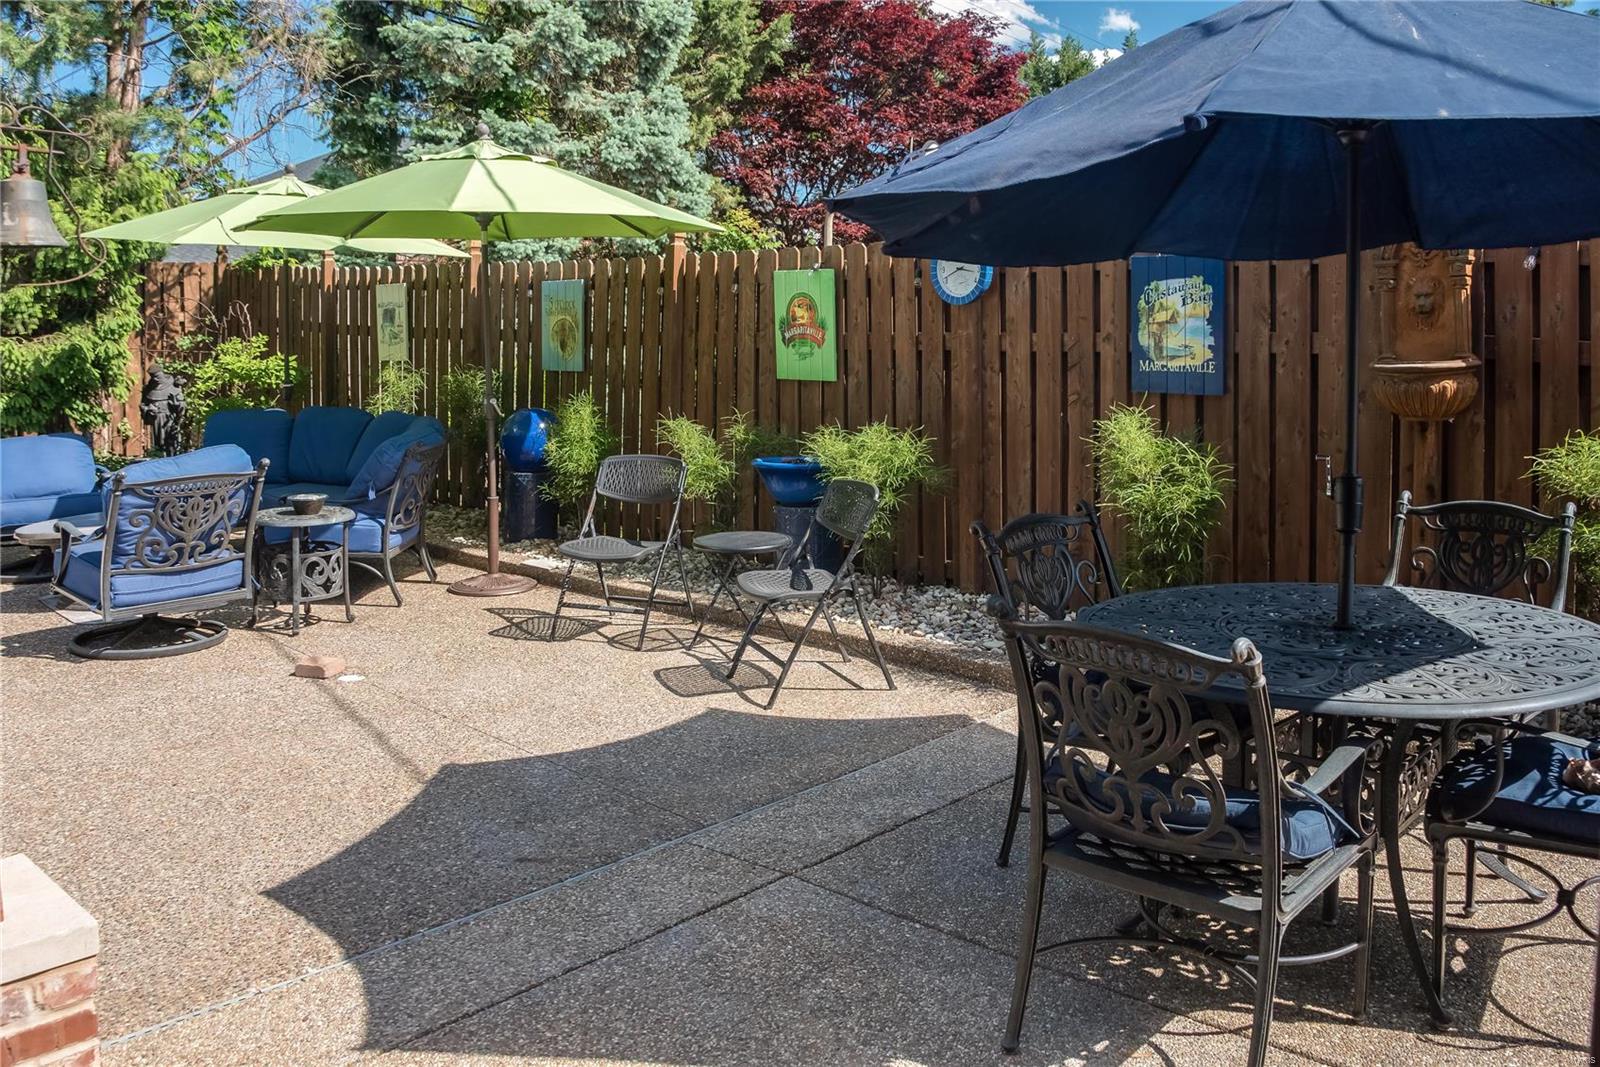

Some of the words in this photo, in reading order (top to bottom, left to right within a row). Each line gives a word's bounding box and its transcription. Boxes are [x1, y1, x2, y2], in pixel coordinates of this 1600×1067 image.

[1144, 282, 1201, 306] Castaway
[1181, 292, 1212, 307] Bay
[1139, 359, 1216, 374] MARGARITAVILLE
